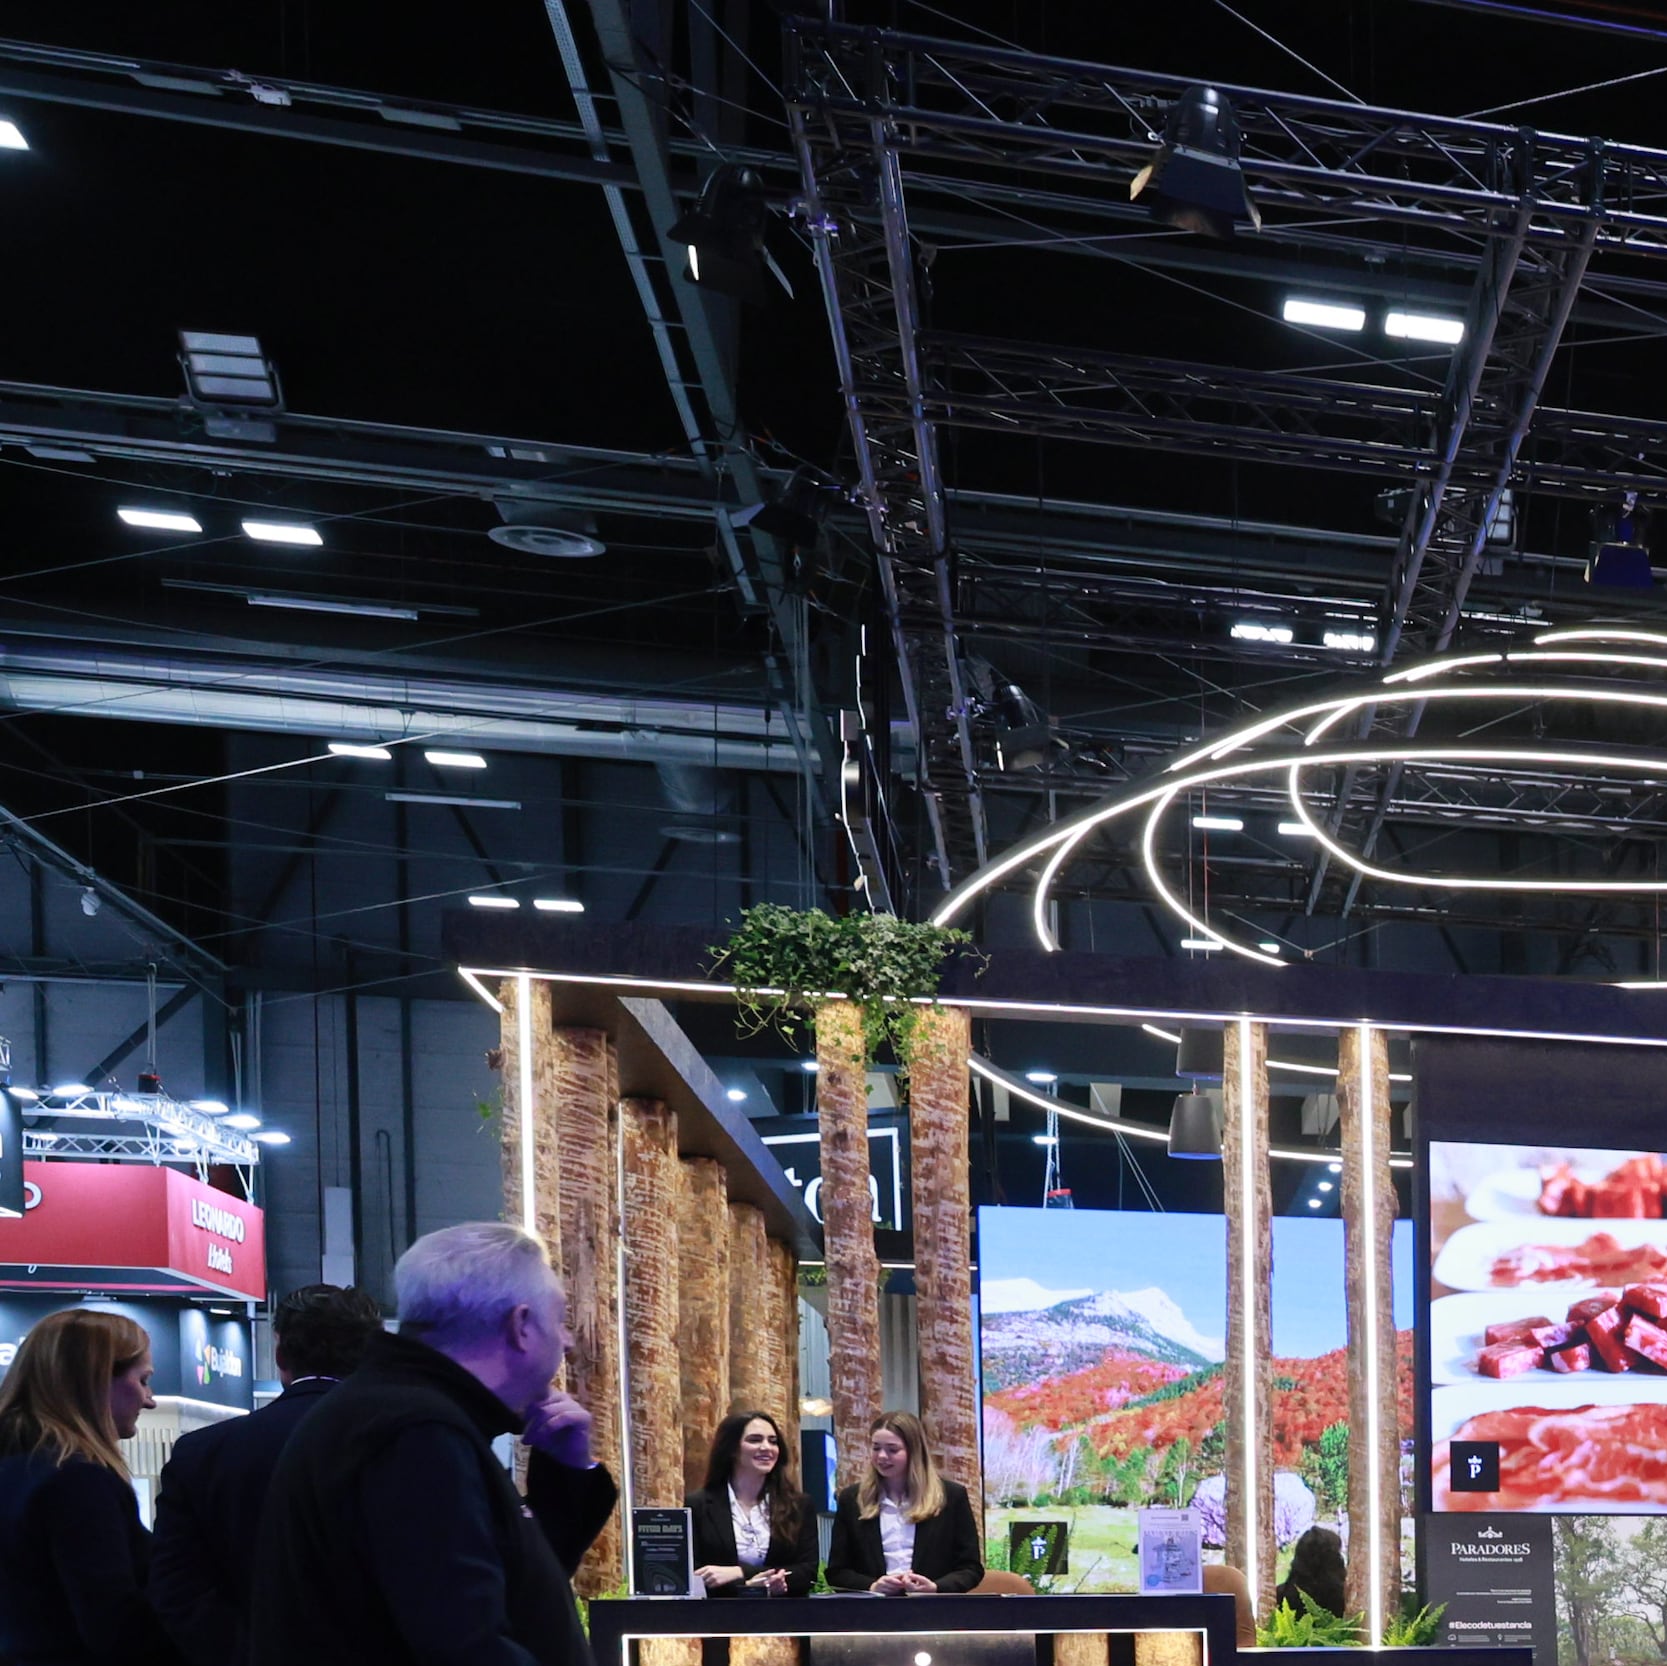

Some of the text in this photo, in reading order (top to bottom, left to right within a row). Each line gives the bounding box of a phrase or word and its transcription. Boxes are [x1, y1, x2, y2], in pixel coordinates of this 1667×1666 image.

[191, 1198, 245, 1243] LEONARDO
[207, 1242, 233, 1275] Hotels
[1451, 1542, 1532, 1556] PARADORES
